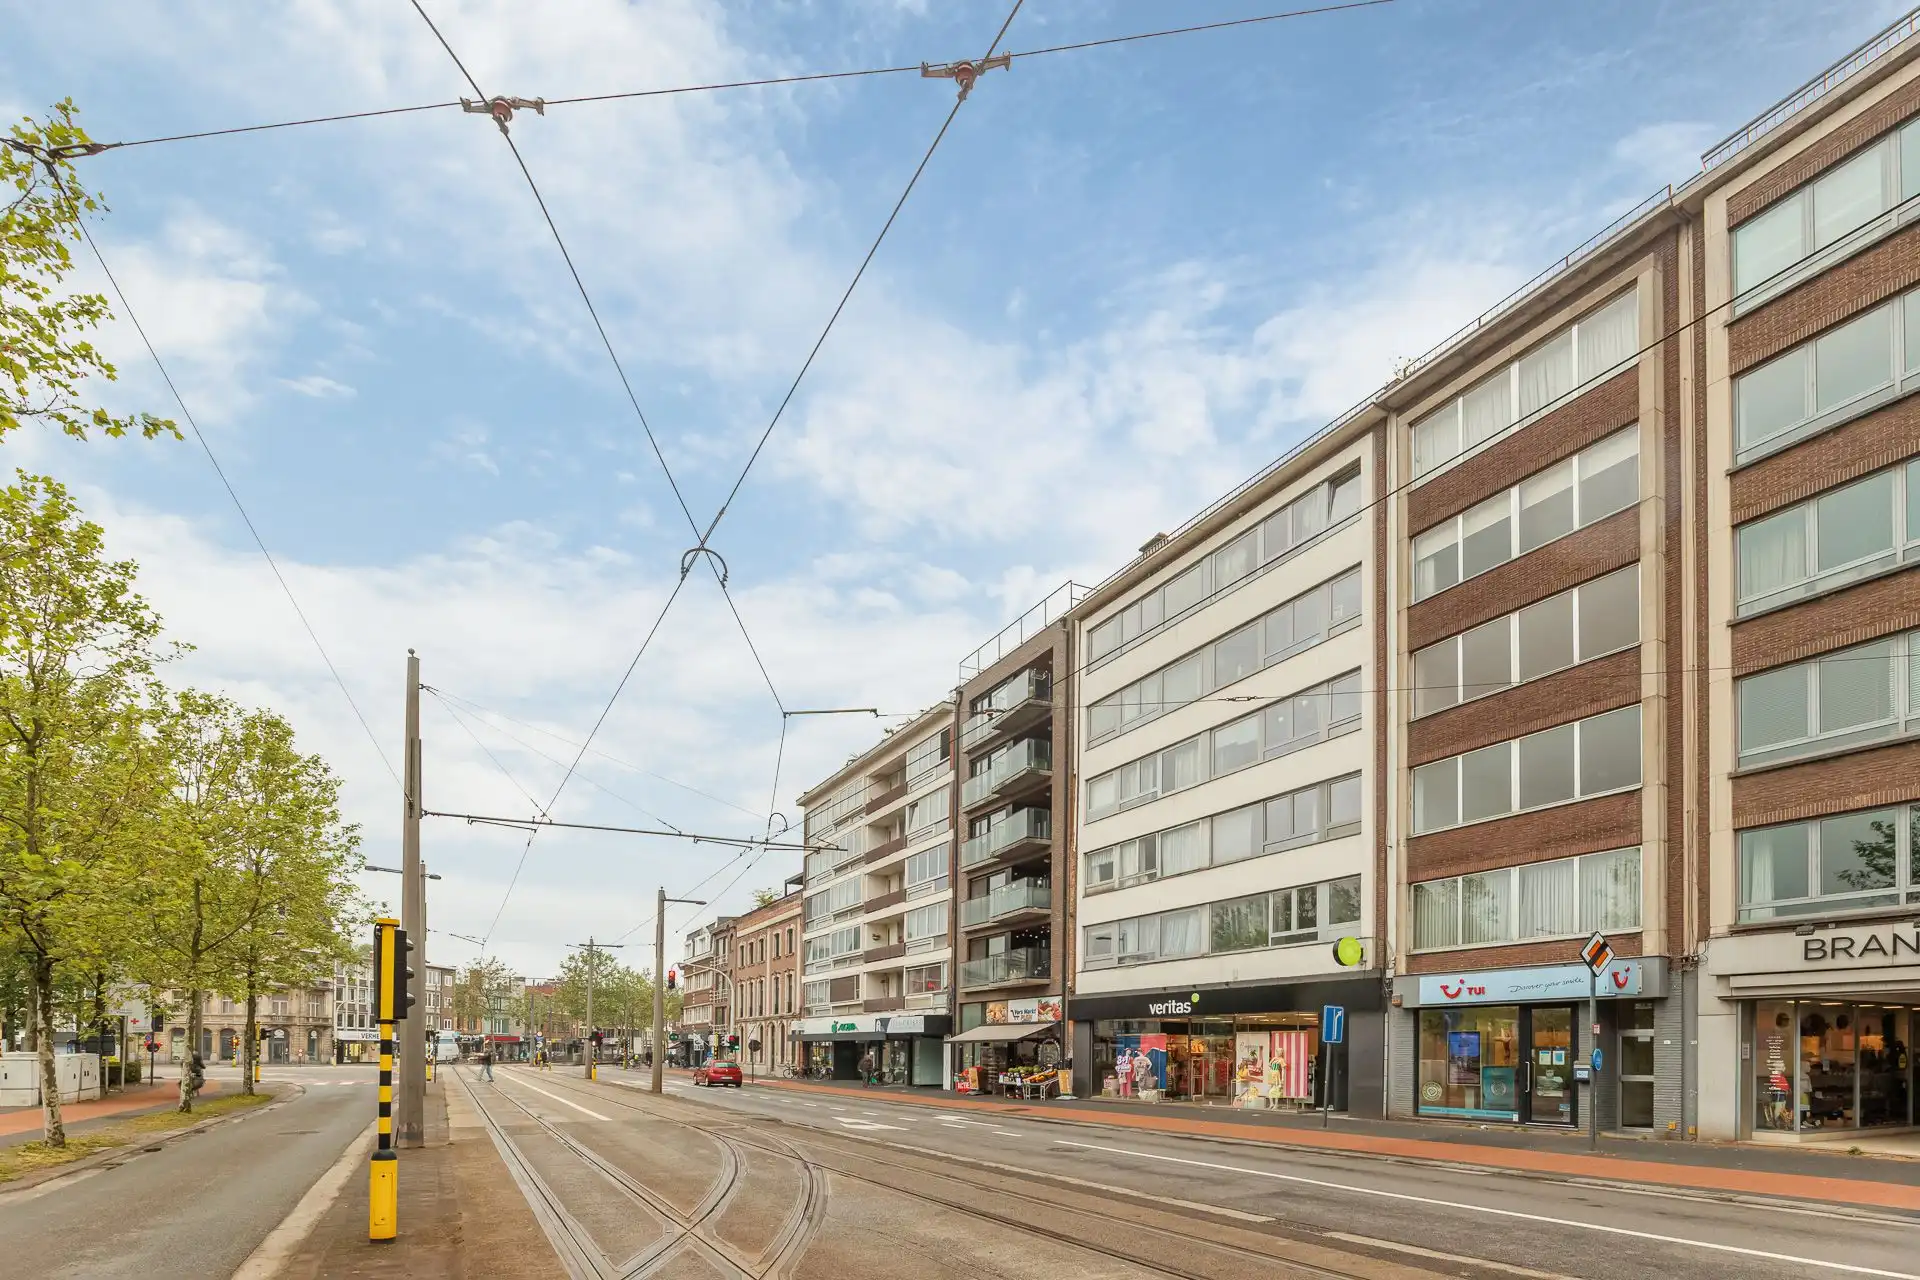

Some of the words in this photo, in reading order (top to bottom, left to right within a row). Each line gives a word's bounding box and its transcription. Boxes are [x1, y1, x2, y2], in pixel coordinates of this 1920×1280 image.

[1803, 931, 1920, 961] BRAN
[1466, 986, 1486, 996] TUI
[1508, 983, 1544, 993] Discover
[1544, 981, 1560, 992] your
[1149, 999, 1192, 1015] veritas
